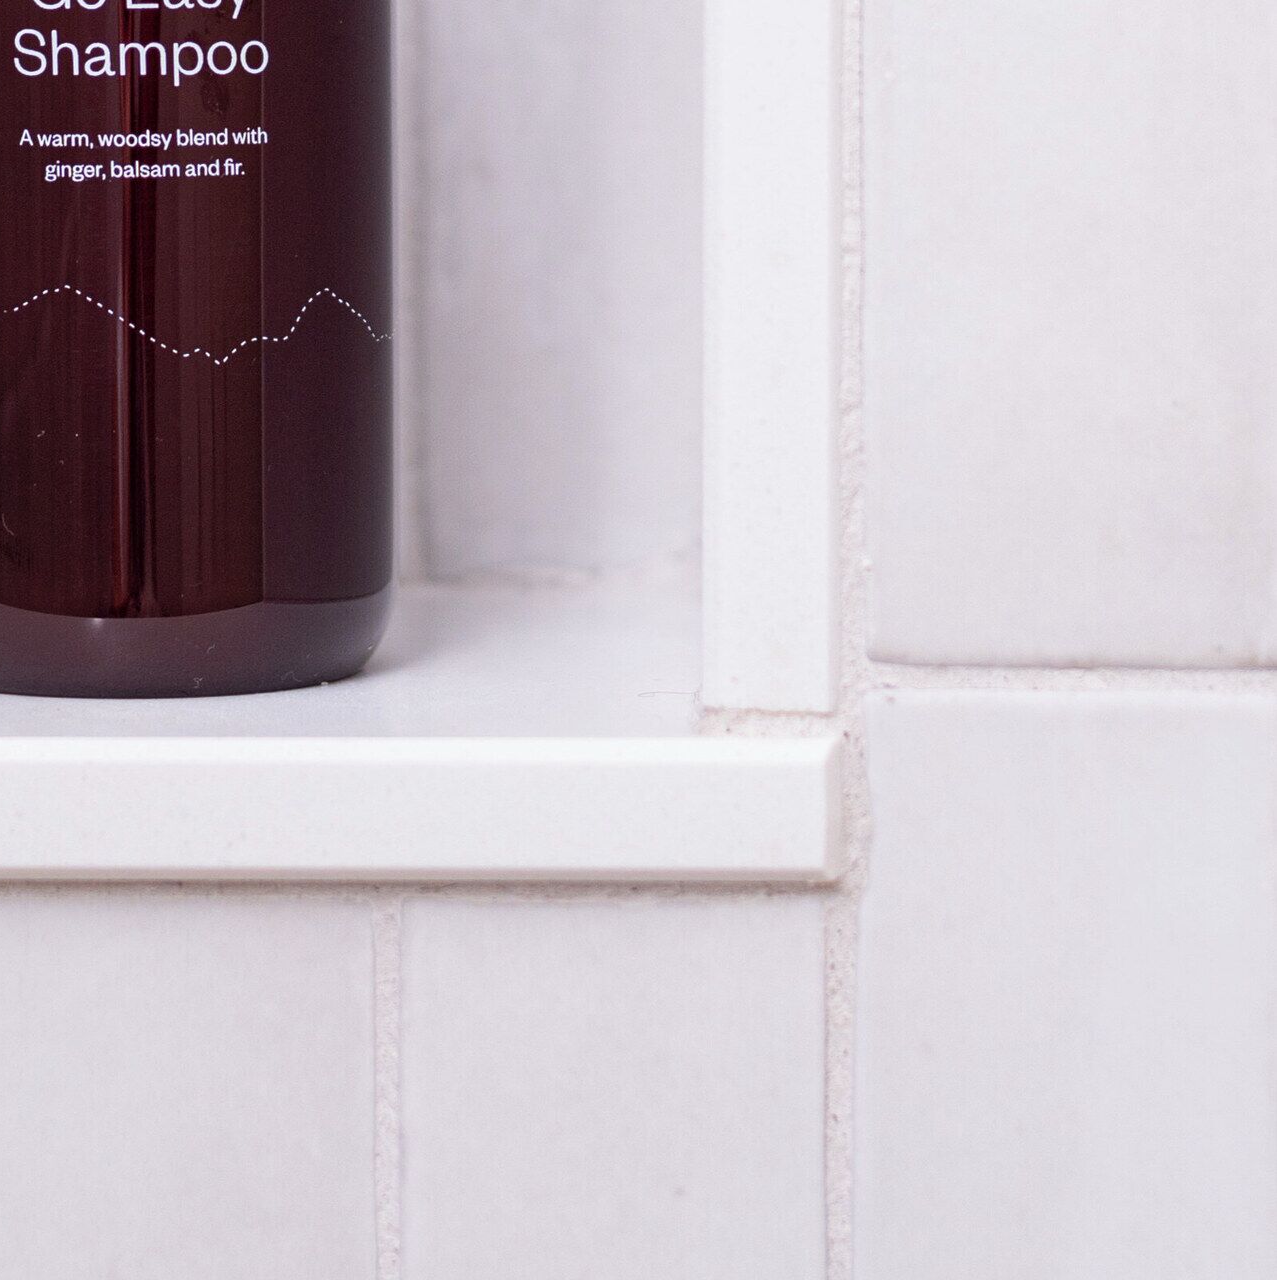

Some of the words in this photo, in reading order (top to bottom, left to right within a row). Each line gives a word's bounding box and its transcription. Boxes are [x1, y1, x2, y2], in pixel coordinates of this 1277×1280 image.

[13, 28, 269, 87] Shampoo
[19, 128, 34, 147] A
[36, 133, 94, 150] warm,
[97, 129, 173, 151] woodsy
[176, 127, 229, 147] blend
[231, 126, 268, 145] with
[44, 160, 107, 183] ginger,
[110, 160, 181, 179] balsam
[184, 158, 220, 178] and
[223, 157, 246, 176] fir.
